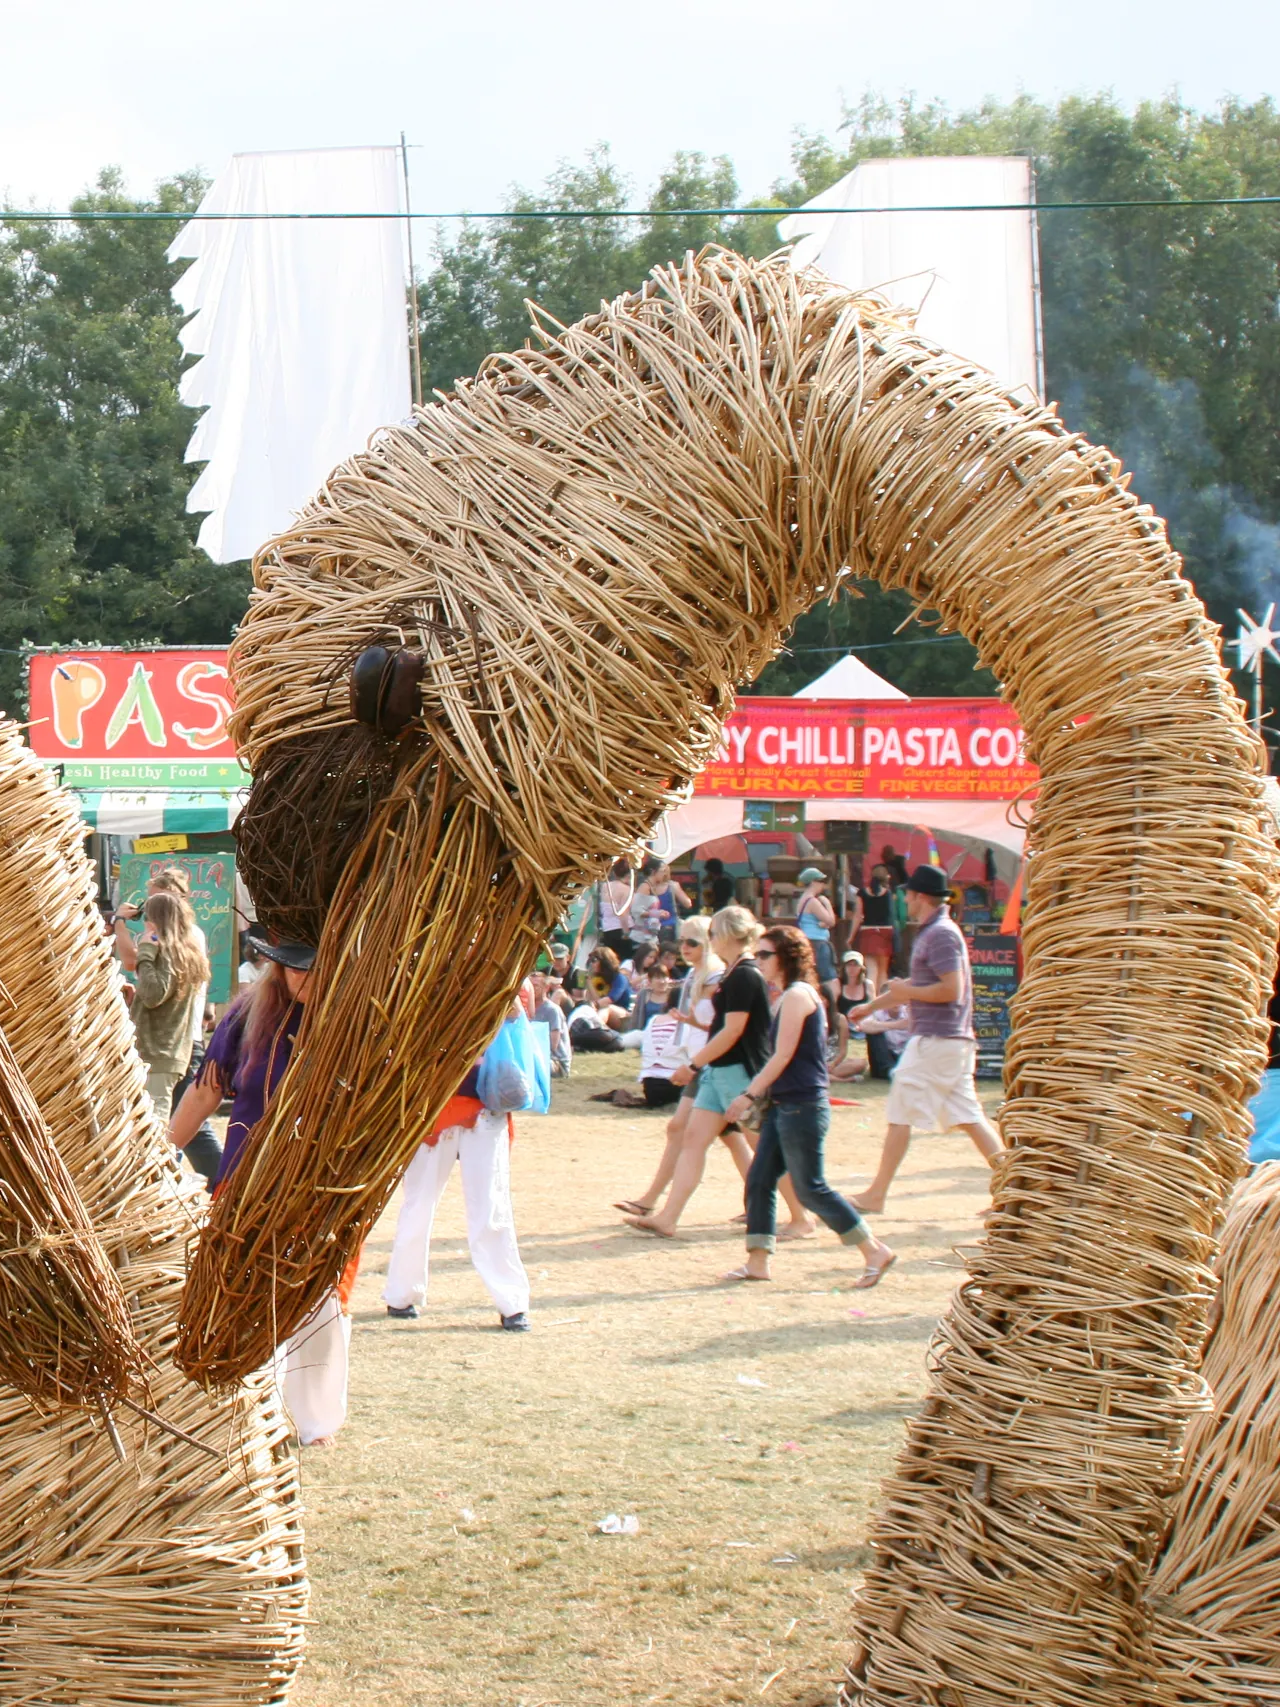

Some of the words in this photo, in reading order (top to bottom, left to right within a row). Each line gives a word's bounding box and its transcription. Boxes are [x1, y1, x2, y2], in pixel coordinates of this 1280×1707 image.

[51, 661, 233, 750] PAS
[757, 726, 855, 764] CHILLI
[863, 727, 963, 766] PASTA
[99, 765, 163, 780] Healthy
[170, 765, 208, 779] Food
[784, 766, 820, 777] Great
[904, 767, 945, 777] Cheers
[948, 767, 984, 780] Roger
[987, 768, 1009, 777] and
[711, 776, 864, 792] FURNACE
[968, 949, 1016, 965] RNACE
[972, 965, 1014, 976] ETARIAN
